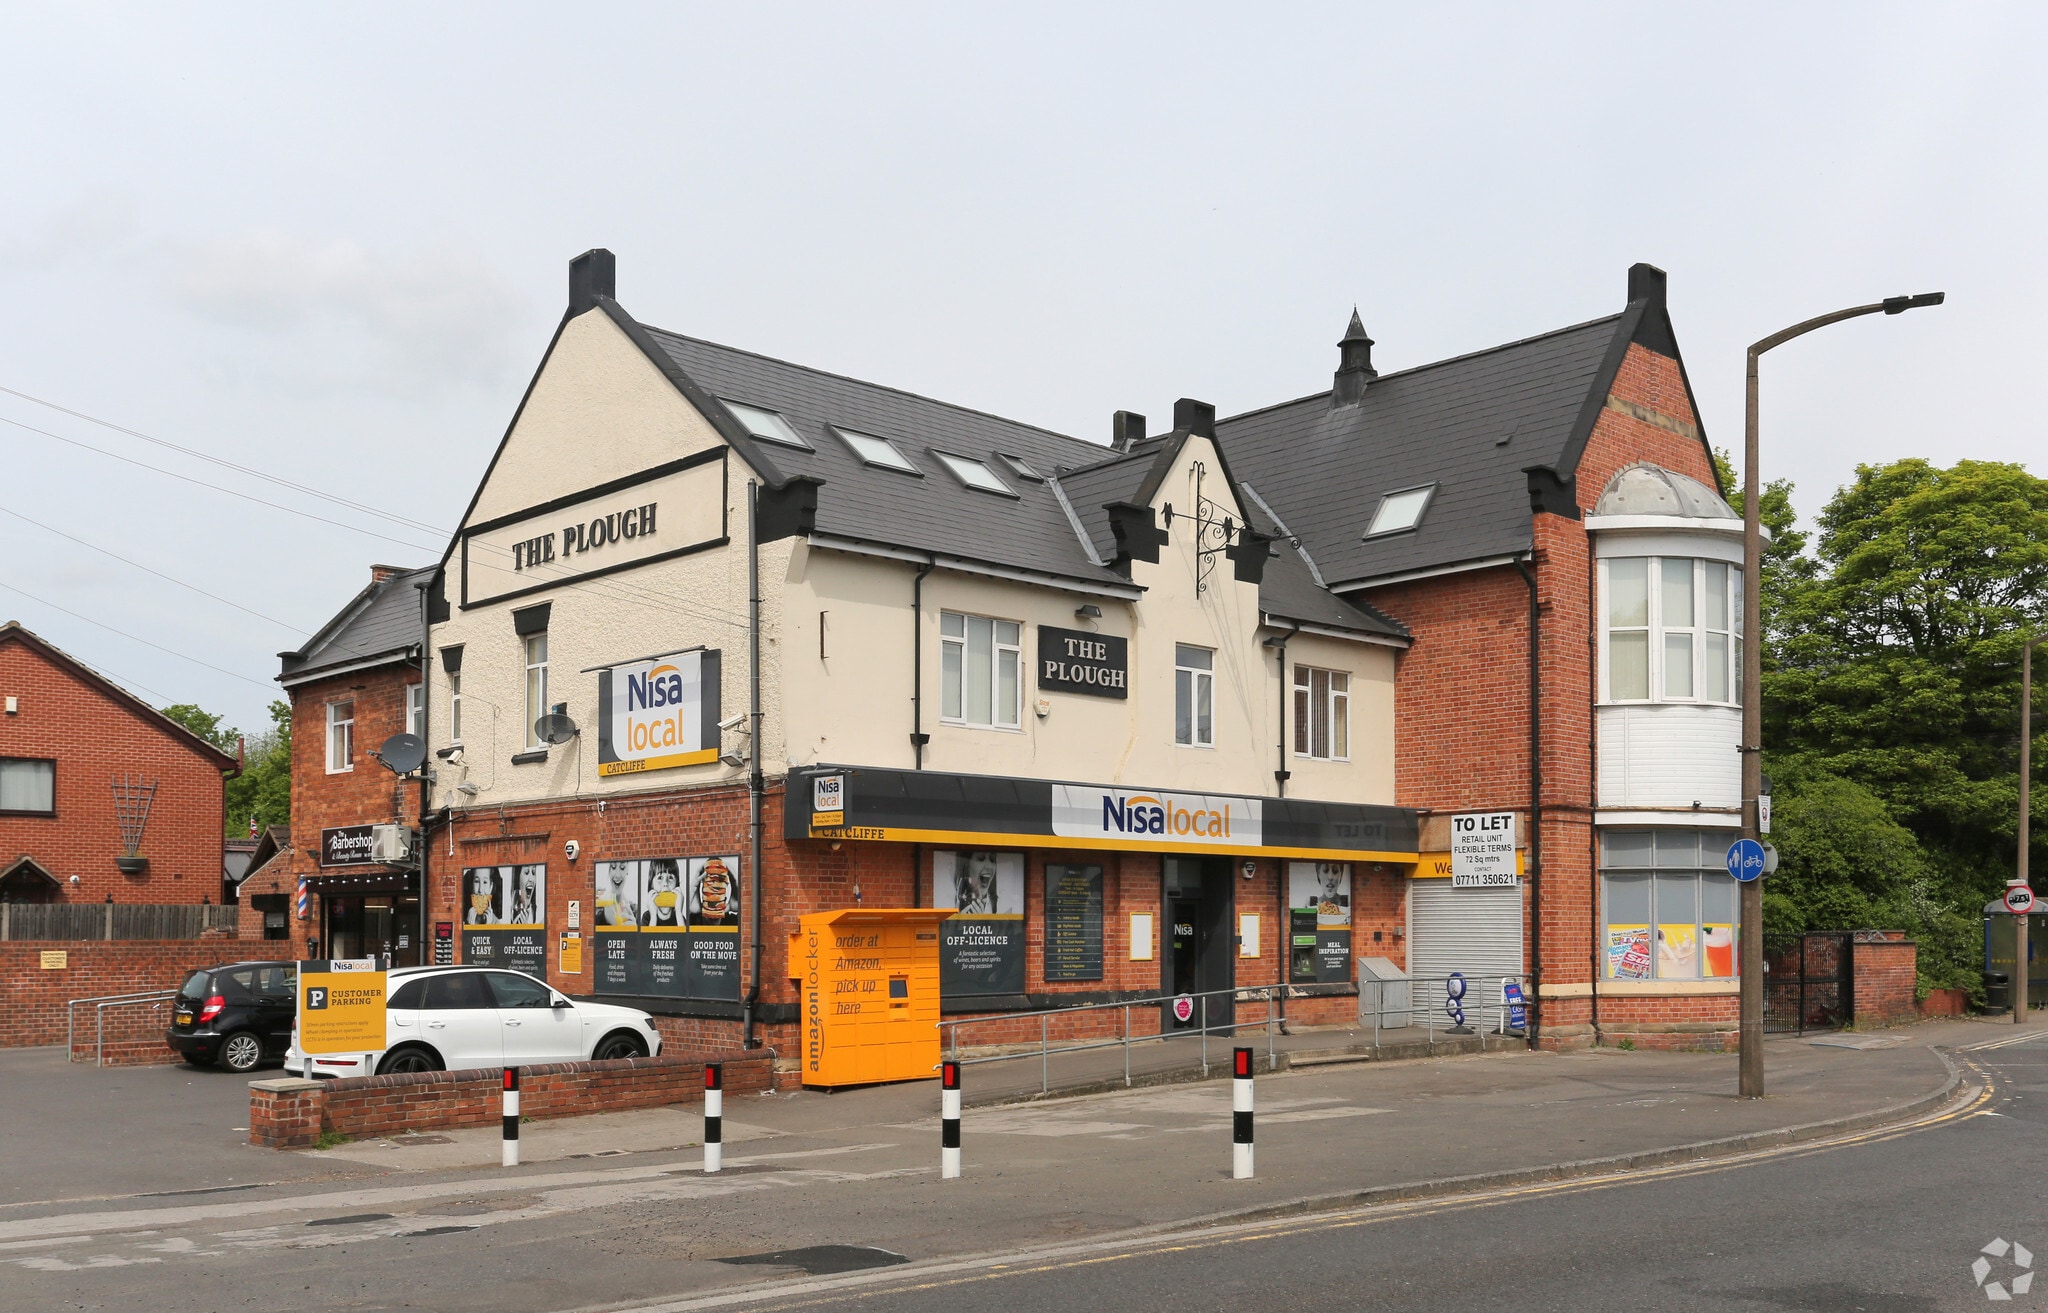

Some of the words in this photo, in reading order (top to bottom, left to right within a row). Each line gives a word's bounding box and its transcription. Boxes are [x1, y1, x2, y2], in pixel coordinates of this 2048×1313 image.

[512, 533, 556, 571] THE
[562, 503, 657, 557] PLOUGH
[1064, 638, 1107, 661] THE
[1045, 660, 1125, 688] PLOUGH
[628, 670, 683, 711] Nisa
[628, 708, 684, 752] local
[606, 759, 646, 774] CATCLIFFE
[818, 780, 839, 793] Nisa
[818, 794, 839, 807] local
[1454, 817, 1475, 831] TO
[1481, 815, 1511, 830] LET
[822, 828, 885, 839] CATCLIFFE
[1461, 835, 1484, 843] RETAIL
[1487, 834, 1503, 842] UNIT
[332, 832, 373, 851] Barbershop
[1454, 845, 1485, 853] FLEXIBLE
[1487, 844, 1512, 852] TERMS
[1475, 855, 1483, 864] Sq
[1455, 875, 1479, 885] 07711
[1482, 874, 1513, 885] 350621
[963, 925, 993, 935] LOCAL
[1174, 923, 1193, 935] Nisa
[472, 936, 491, 945] QUICK
[513, 936, 533, 944] LOCAL
[607, 940, 626, 949] OPEN
[649, 940, 678, 949] ALWAYS
[693, 941, 714, 950] GOOD
[715, 941, 734, 950] FOOD
[835, 934, 866, 948] order
[867, 934, 879, 947] at
[946, 936, 1008, 946] OFF-LICENCE
[471, 946, 476, 955] &
[476, 946, 492, 955] EASY
[504, 946, 543, 955] OFF-LICENCE
[608, 950, 625, 960] LATE
[652, 950, 675, 960] FRESH
[690, 950, 701, 959] ON
[702, 951, 716, 959] THE
[717, 951, 737, 960] MOVE
[835, 956, 881, 971] Amazon,
[835, 978, 859, 996] pick
[862, 980, 876, 994] up
[310, 990, 324, 1007] P
[331, 989, 382, 998] CUSTOMER
[331, 998, 372, 1006] PARKING
[836, 1001, 861, 1015] here
